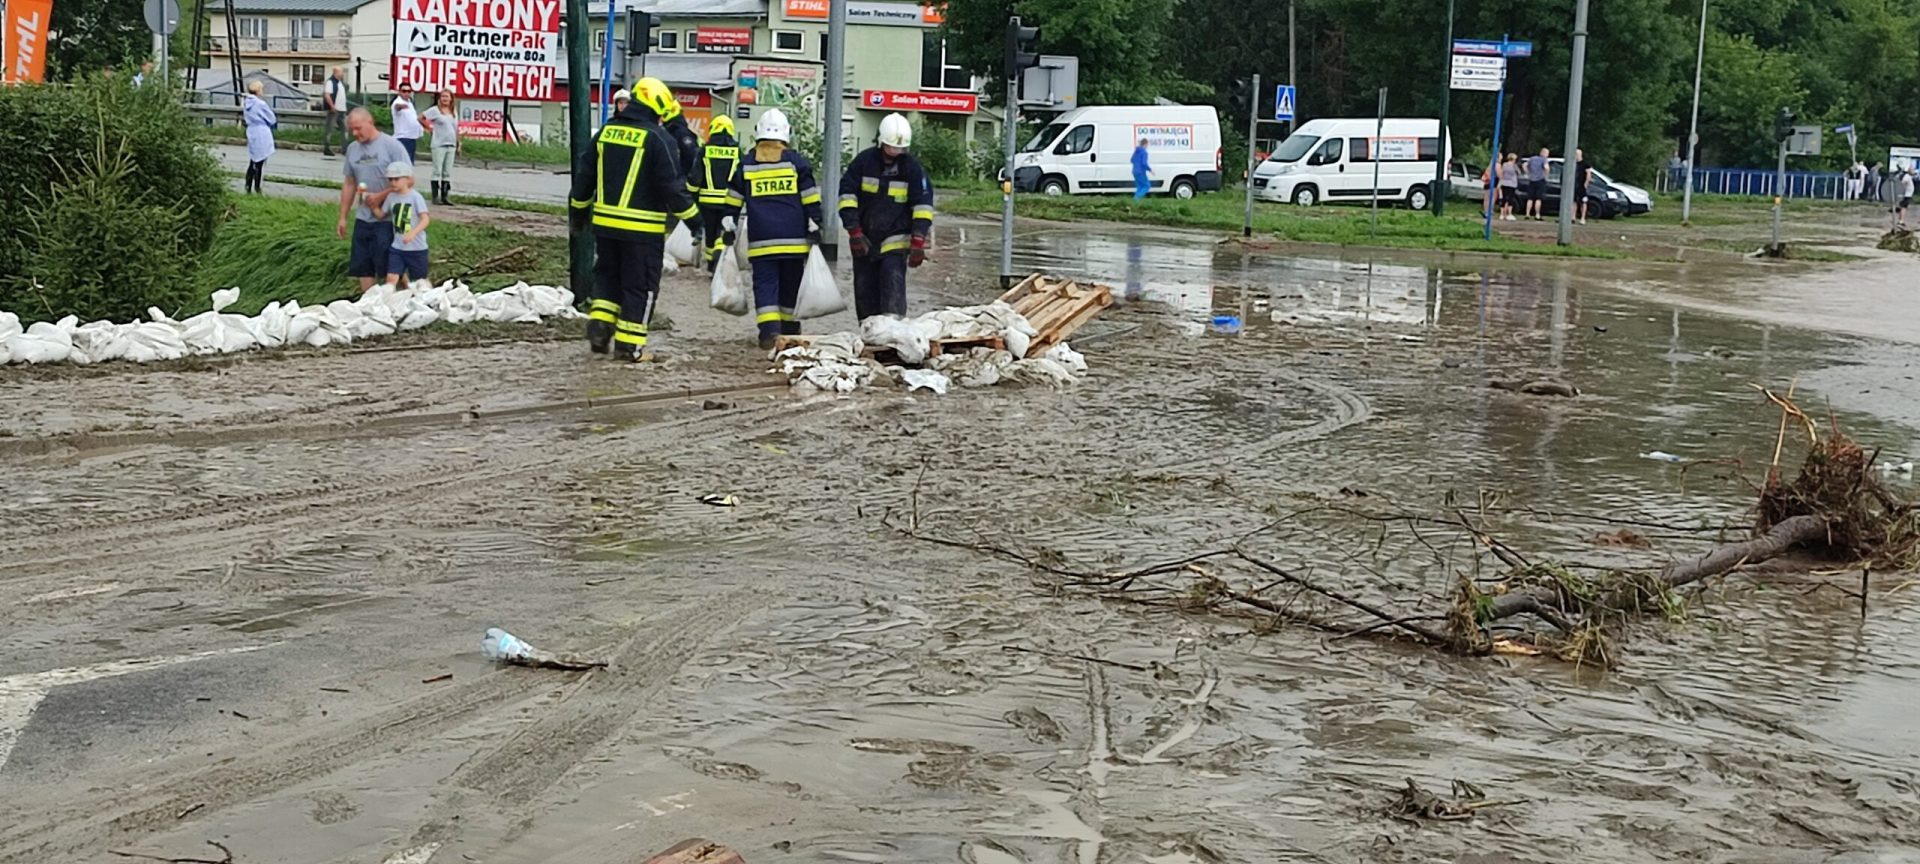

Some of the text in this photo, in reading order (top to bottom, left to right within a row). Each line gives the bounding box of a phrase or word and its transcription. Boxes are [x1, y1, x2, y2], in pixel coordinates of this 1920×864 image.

[789, 0, 826, 11] STIHL
[400, 0, 556, 31] KARTONY
[873, 10, 917, 19] Techniczny
[434, 25, 546, 49] PartnerPak
[434, 45, 546, 62] ul. Dunajcowa 80a
[397, 57, 553, 99] FOLIE STRETCH
[891, 95, 918, 104] Salon
[919, 96, 970, 108] Techniczny
